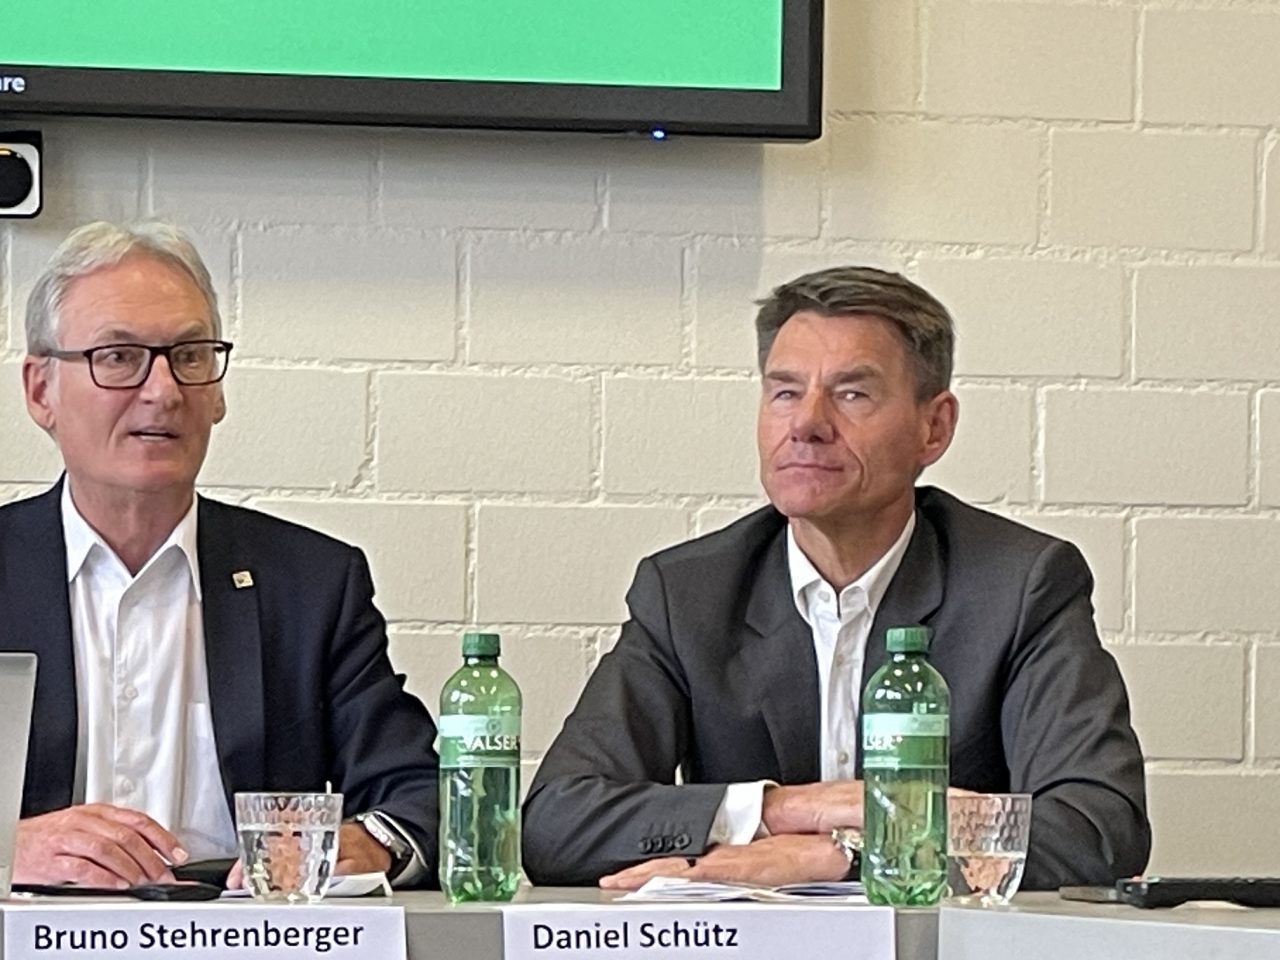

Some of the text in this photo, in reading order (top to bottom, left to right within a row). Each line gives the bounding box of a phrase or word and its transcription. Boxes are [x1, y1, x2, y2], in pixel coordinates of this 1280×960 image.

[34, 919, 364, 953] Bruno Stehrenberger
[533, 920, 738, 950] Daniel Schütz
